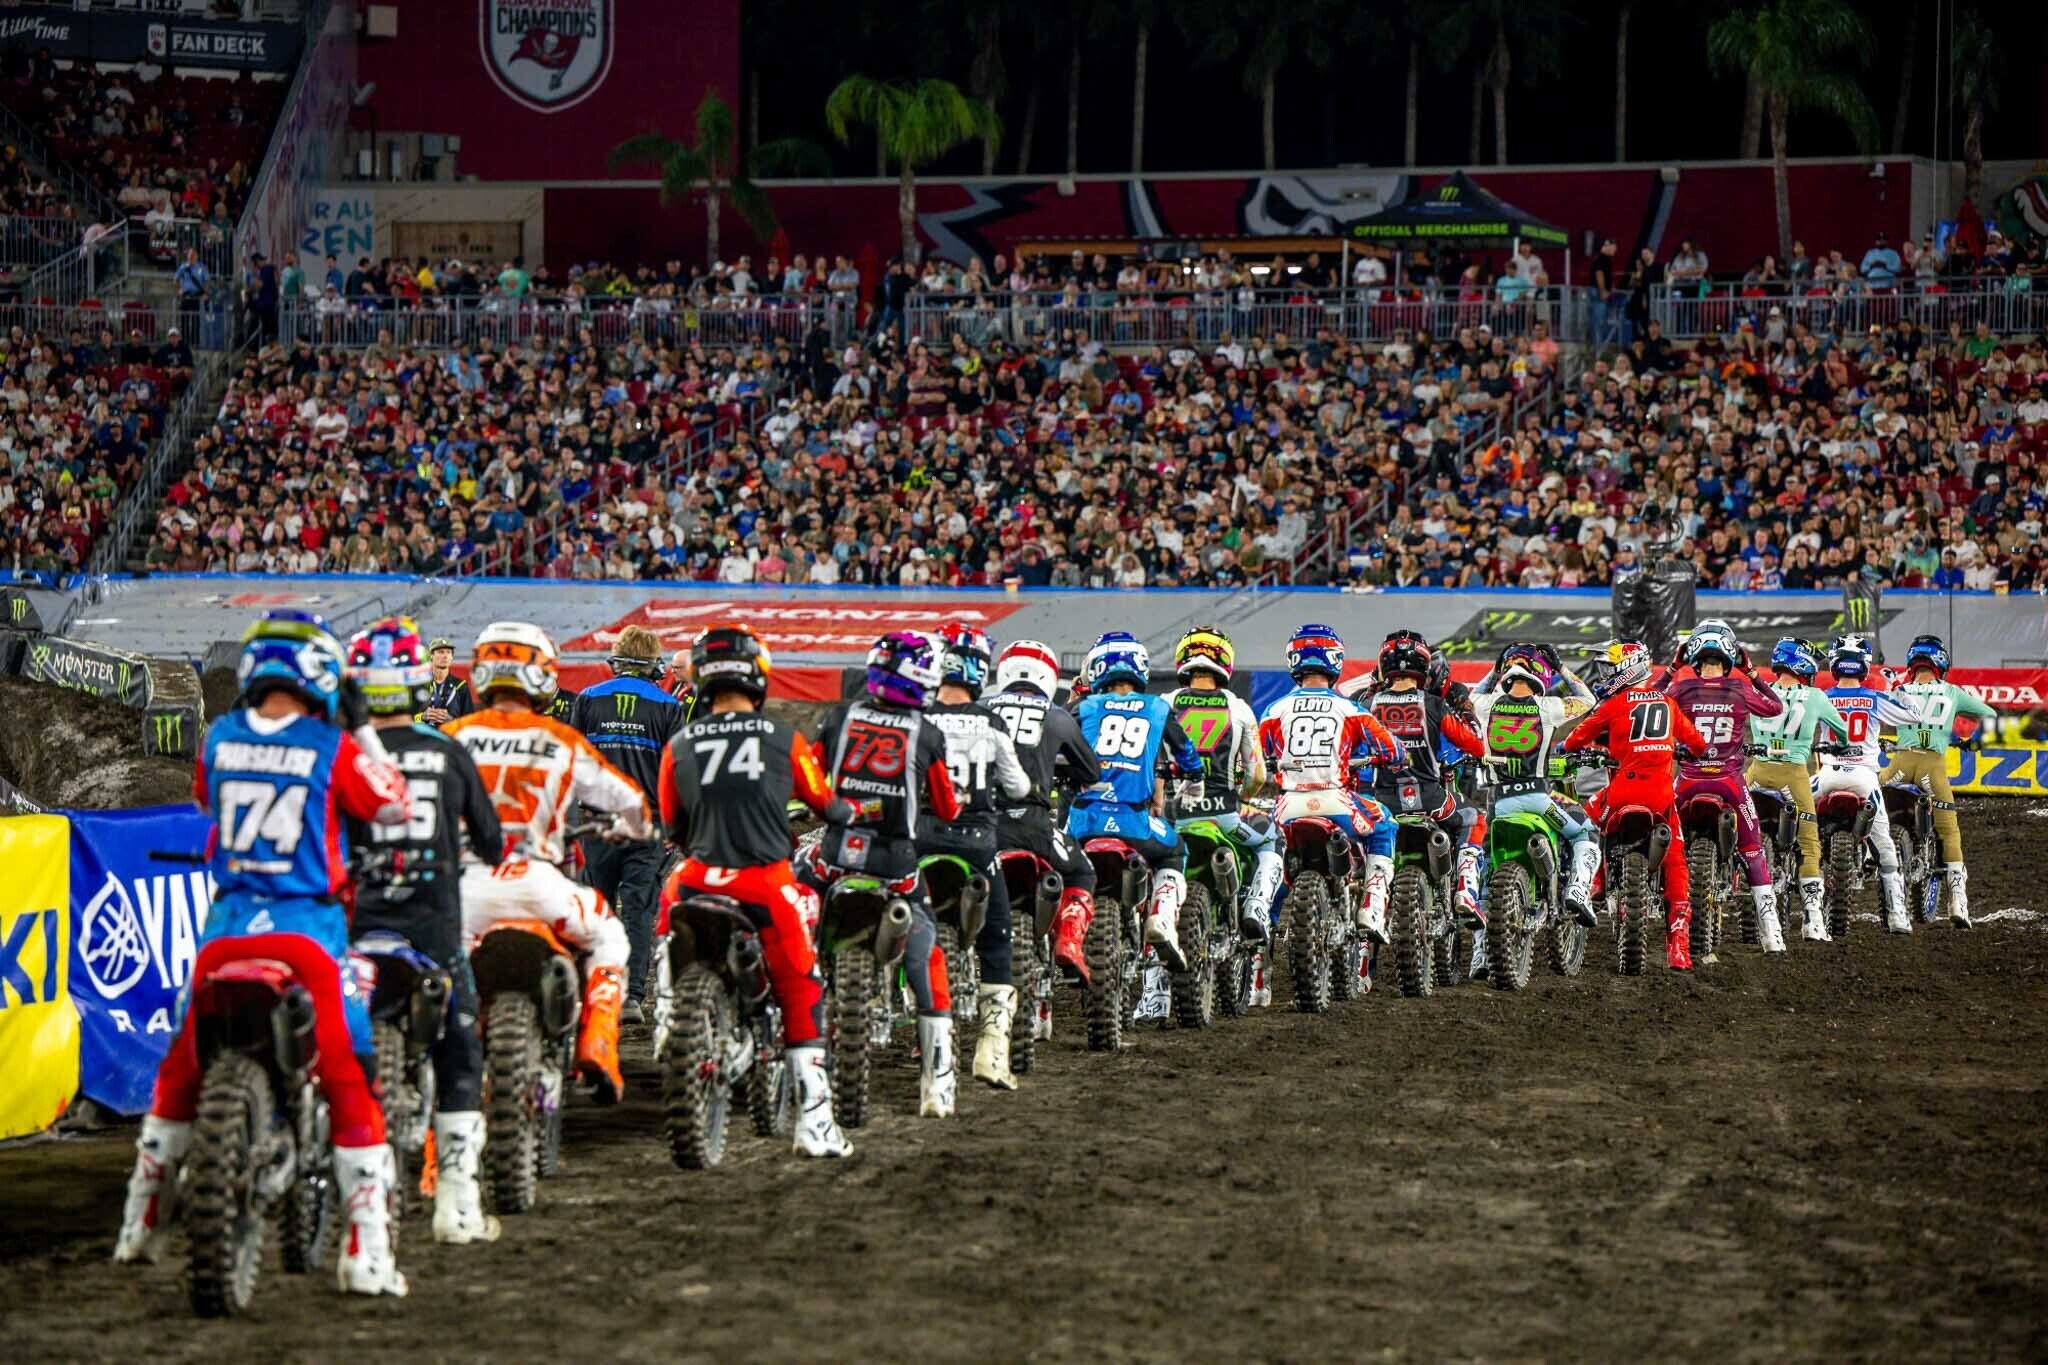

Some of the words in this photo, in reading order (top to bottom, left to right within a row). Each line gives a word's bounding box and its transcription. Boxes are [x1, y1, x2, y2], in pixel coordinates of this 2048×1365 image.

[35, 24, 71, 41] TIME
[497, 8, 596, 38] CHAMPIONS
[172, 33, 208, 52] FAN
[213, 36, 265, 55] DECK
[1353, 225, 1412, 237] OFFICIAL
[1415, 223, 1510, 236] MERCHANDISE
[720, 608, 989, 620] HONDA
[53, 652, 115, 685] MONSTER
[1175, 696, 1226, 706] KITCHEN
[1830, 698, 1873, 709] UMFORD
[1961, 685, 2044, 704] NDA
[1293, 698, 1332, 713] FLOYD
[1491, 703, 1539, 714] HAMMAKER
[1692, 704, 1735, 713] PARK
[601, 721, 646, 732] MONSTER
[684, 719, 775, 739] LOCURCIO
[923, 713, 990, 735] OGERS
[992, 706, 1045, 747] 95
[1178, 707, 1231, 752] 47
[1628, 701, 1670, 742] 10
[1695, 716, 1735, 744] 59
[1095, 714, 1151, 759] 89
[1288, 716, 1337, 757] 82
[1488, 715, 1542, 754] 56
[1633, 744, 1673, 752] HONDA
[694, 737, 766, 785] 74
[849, 778, 906, 797] PARTZILLA
[1502, 783, 1536, 794] FOX
[219, 780, 309, 855] 174
